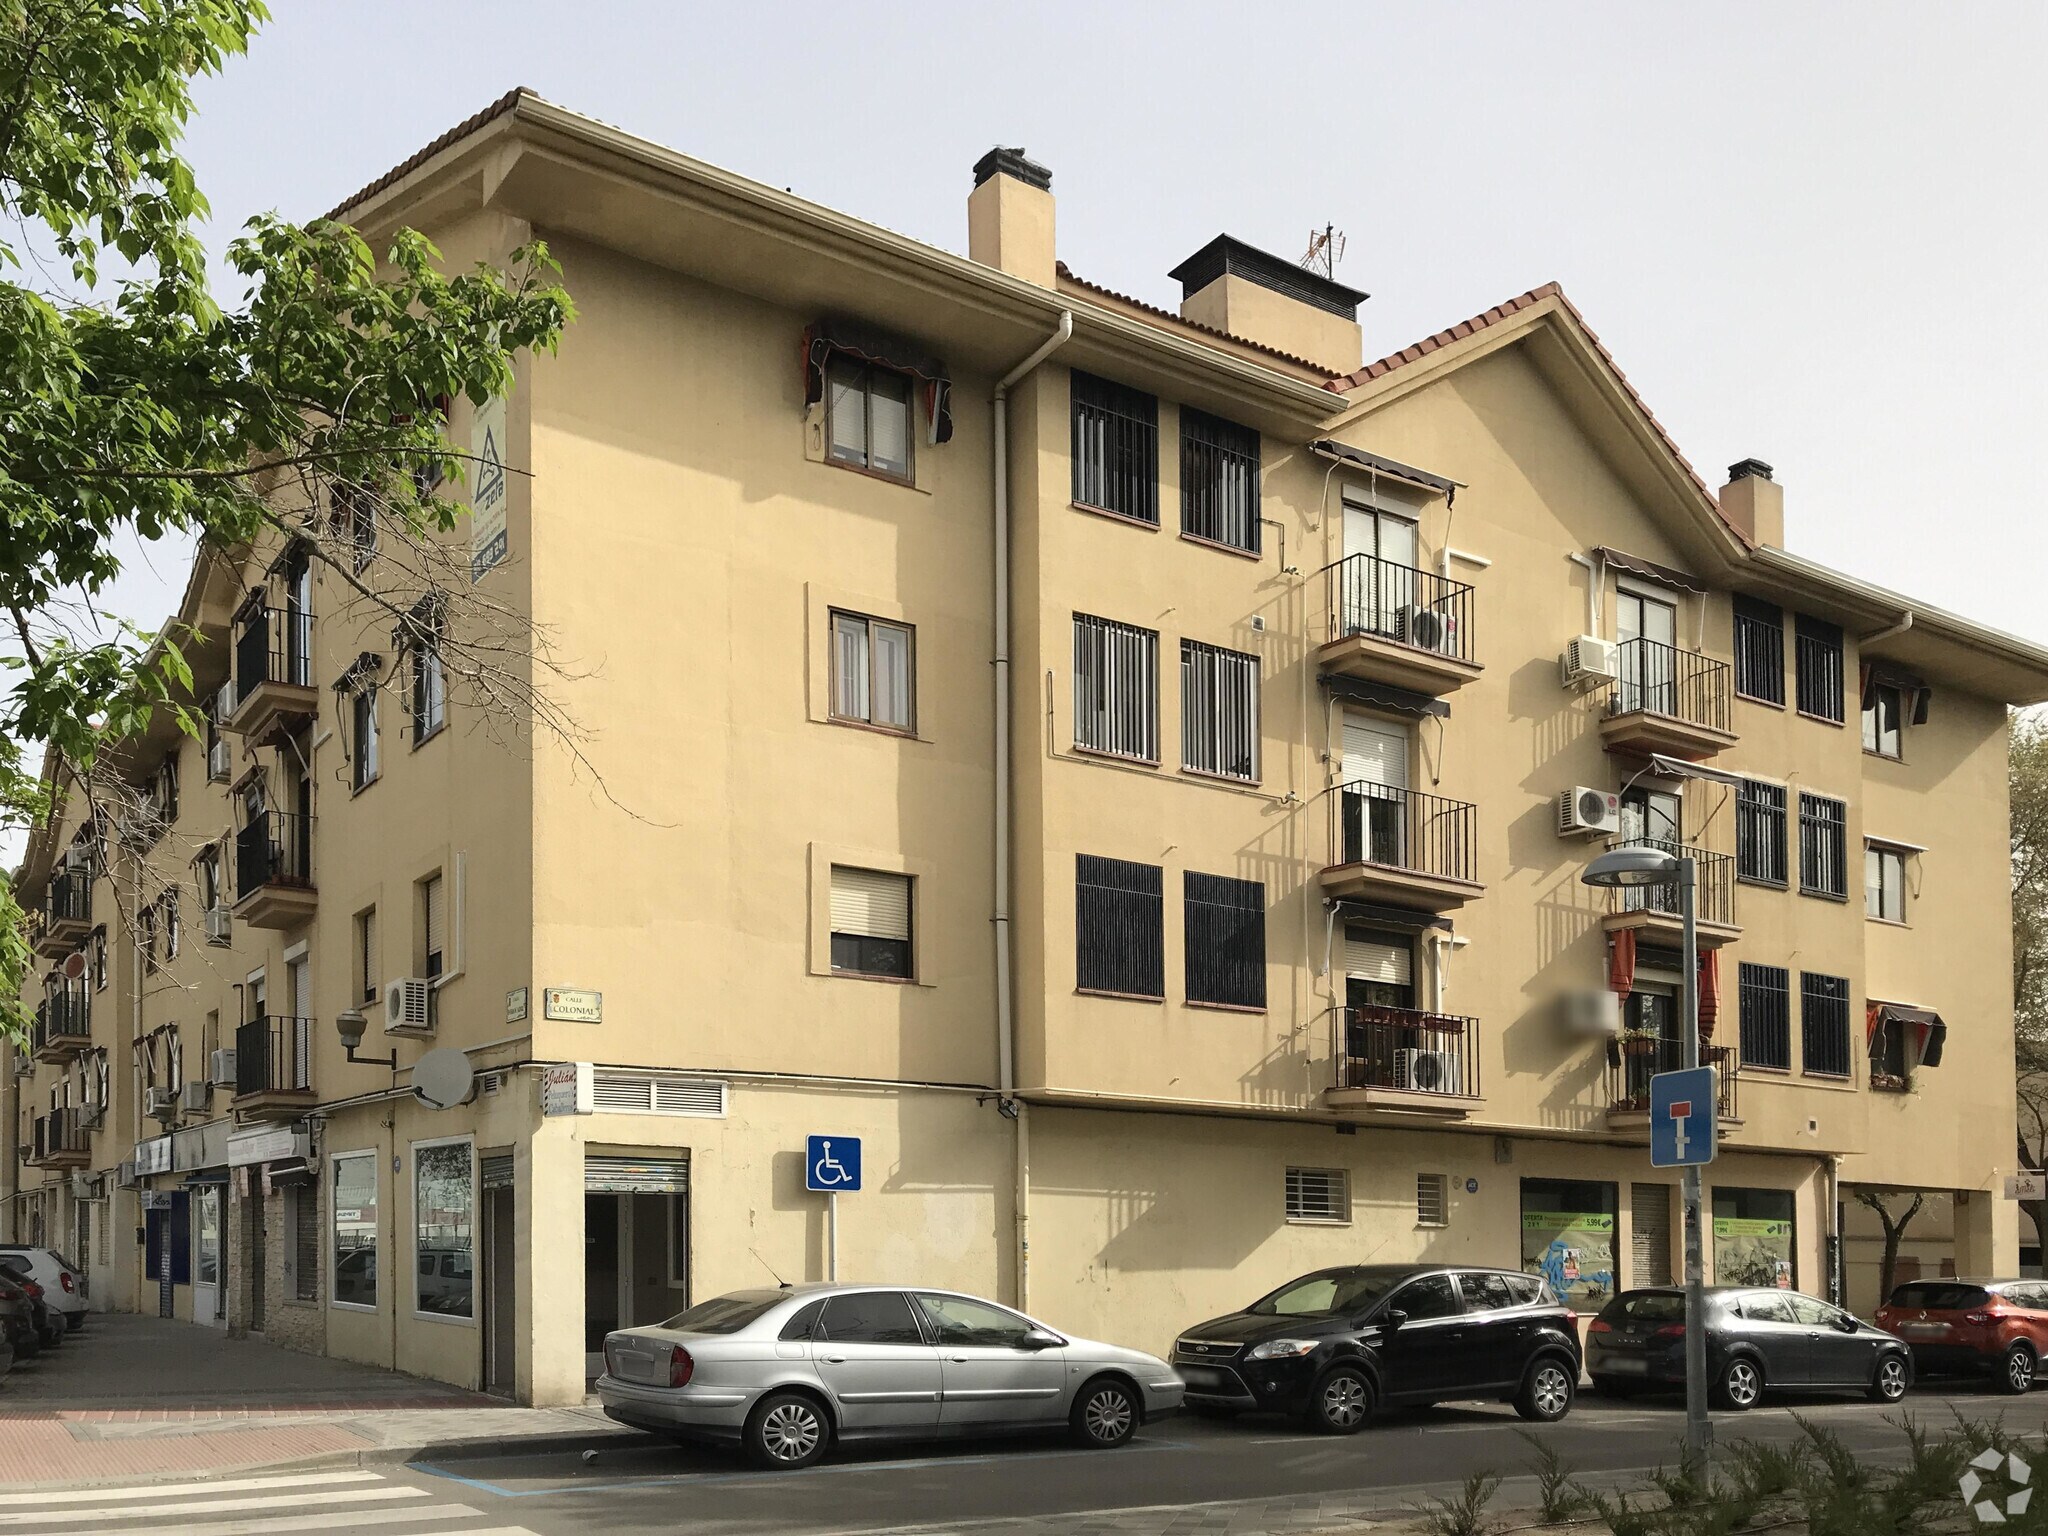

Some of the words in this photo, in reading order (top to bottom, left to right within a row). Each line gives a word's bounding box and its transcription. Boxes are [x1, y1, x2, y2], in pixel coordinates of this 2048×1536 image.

[553, 1006, 595, 1015] COLONIAL
[547, 1070, 573, 1090] Julián
[1586, 1218, 1602, 1228] 5,99€
